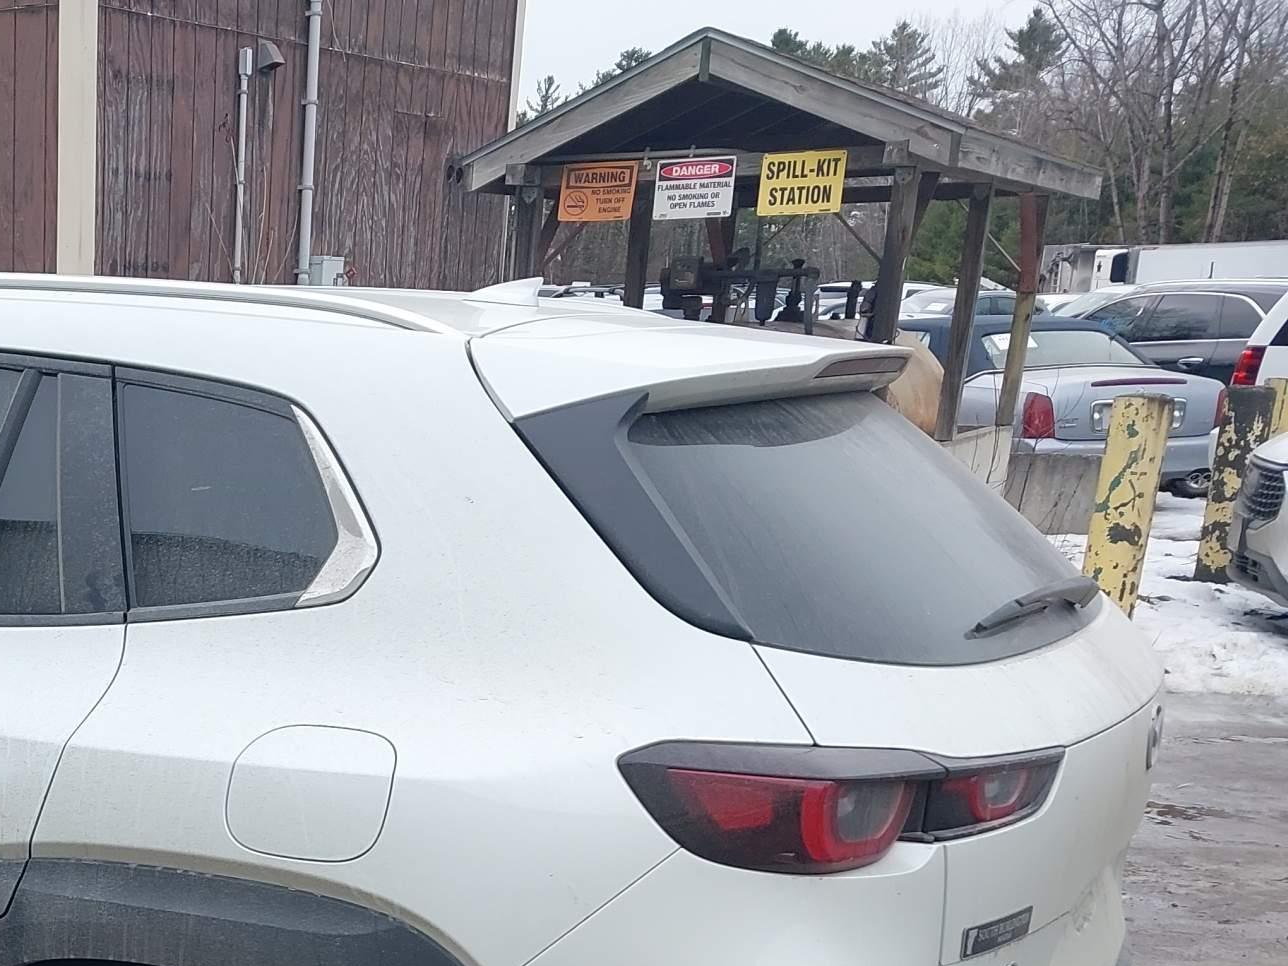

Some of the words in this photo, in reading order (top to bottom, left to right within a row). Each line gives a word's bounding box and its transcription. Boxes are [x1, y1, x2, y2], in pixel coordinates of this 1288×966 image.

[672, 164, 720, 176] DANGER
[766, 158, 841, 180] SPILL-KIT
[574, 170, 626, 184] WARNING
[657, 183, 698, 191] FLAMMABLE
[699, 181, 732, 189] MATERIAL
[768, 184, 832, 206] STATION
